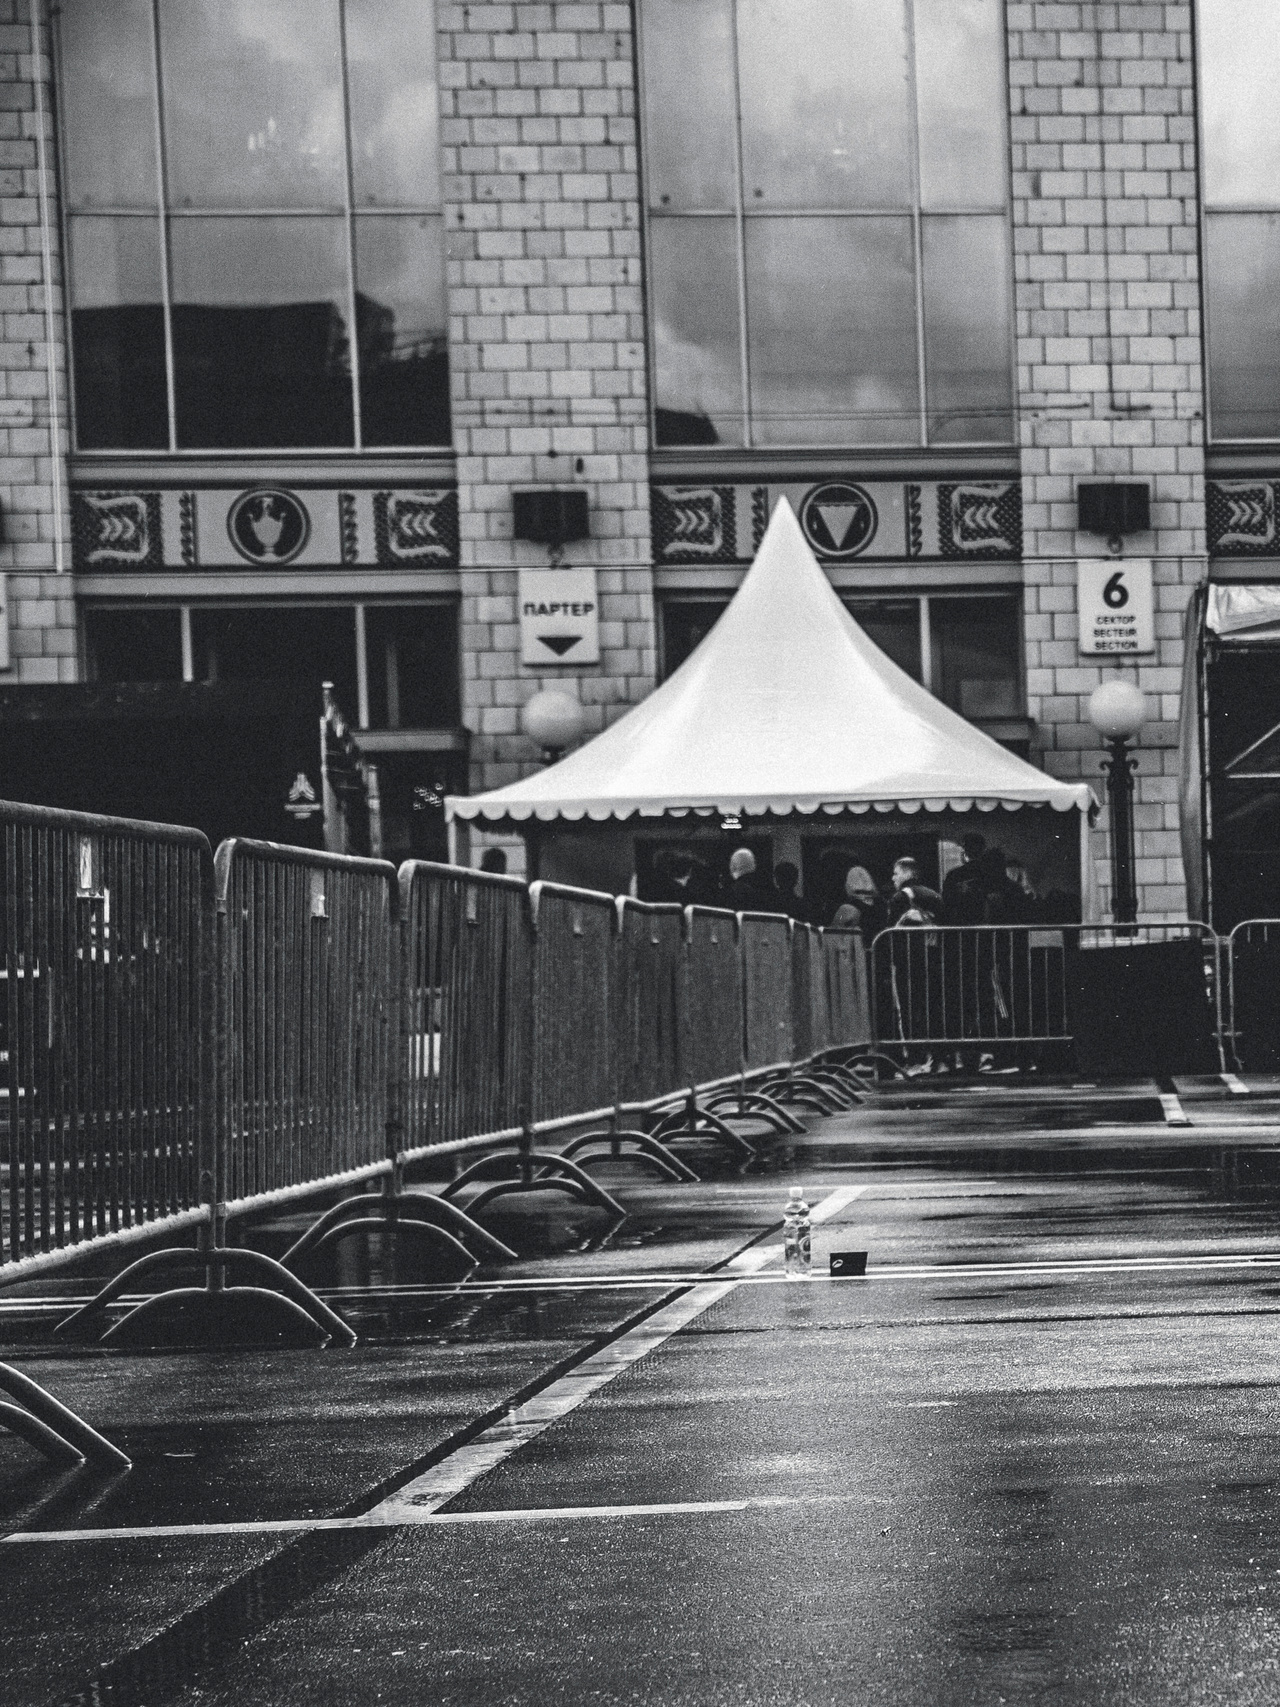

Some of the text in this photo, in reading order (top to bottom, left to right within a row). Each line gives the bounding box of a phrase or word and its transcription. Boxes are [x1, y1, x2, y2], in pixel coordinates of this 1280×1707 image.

[1103, 571, 1130, 610] 6
[523, 602, 595, 617] ПАРТЕР
[1094, 641, 1138, 651] SECTION
